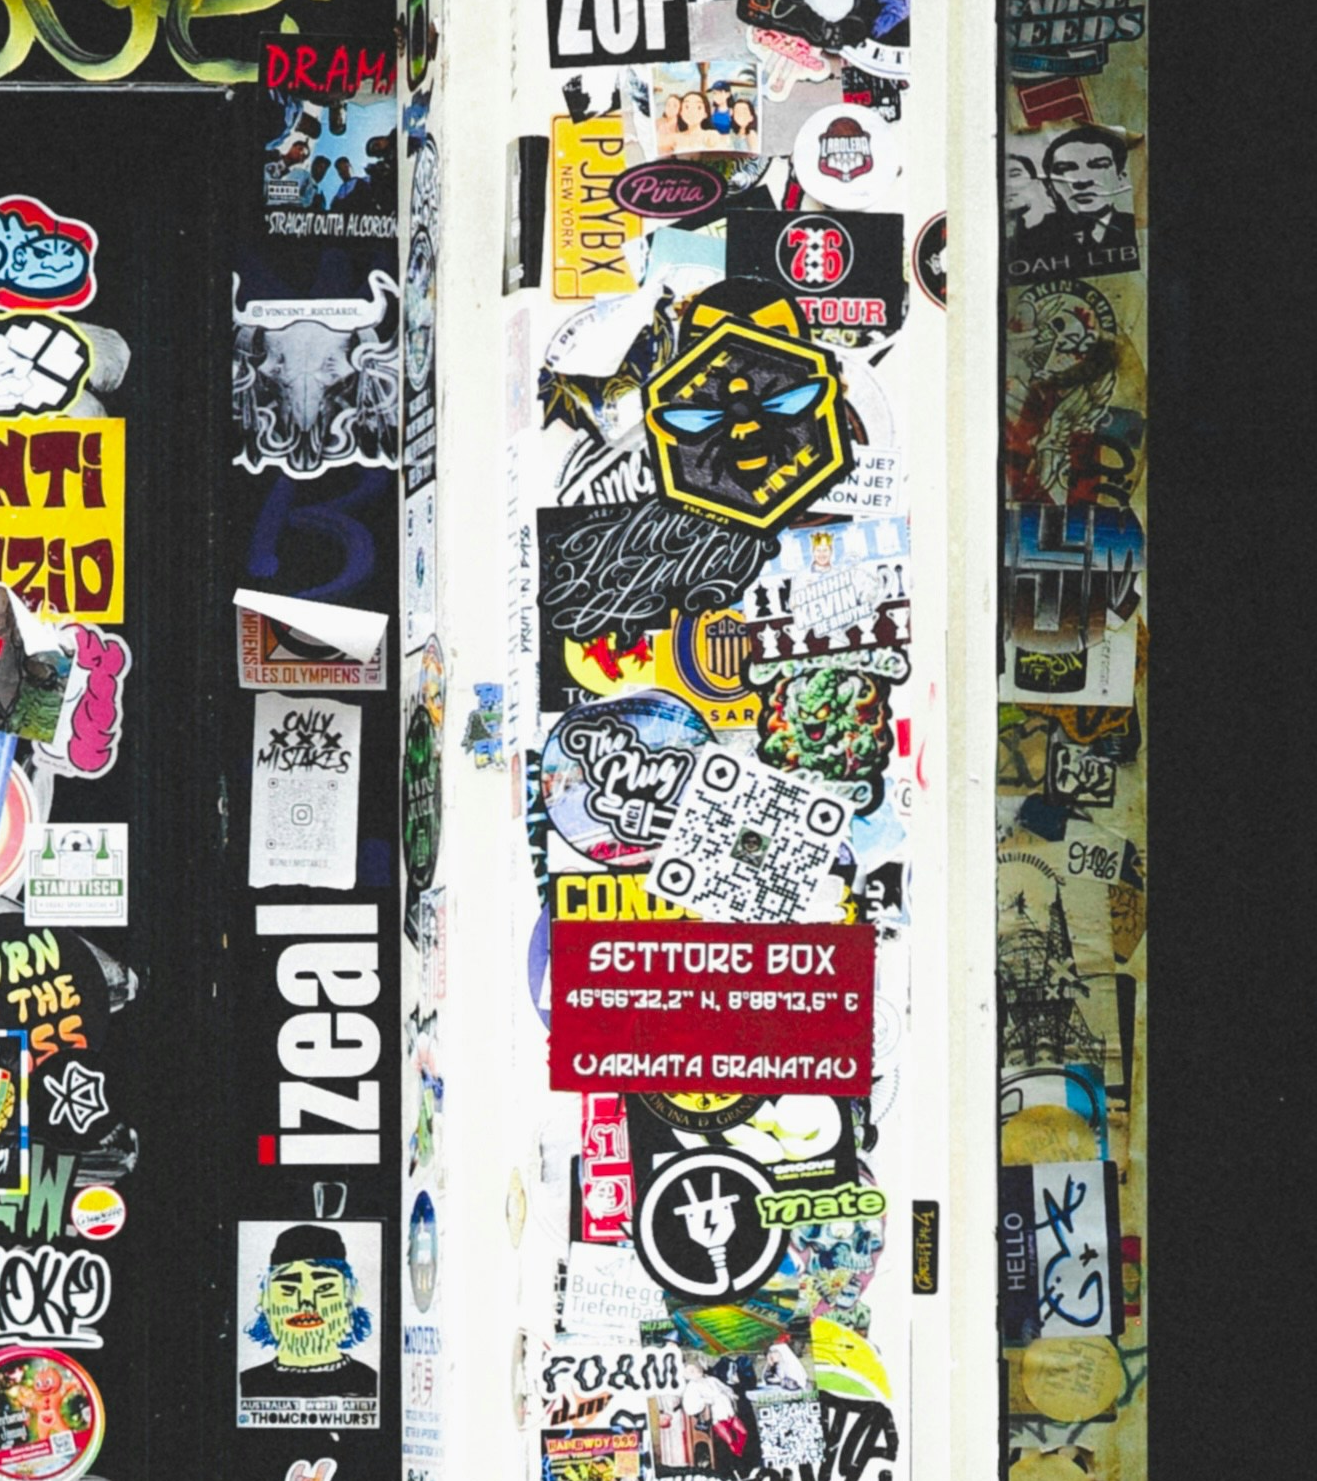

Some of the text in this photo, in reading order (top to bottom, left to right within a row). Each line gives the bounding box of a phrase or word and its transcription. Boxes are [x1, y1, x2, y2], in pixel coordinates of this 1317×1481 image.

[268, 210, 399, 239] STRAIGHT OUTTA ALCORCÓN
[1085, 241, 1139, 272] LTB
[801, 299, 886, 324] TOUR
[257, 746, 351, 773] MISTAKES
[32, 880, 121, 897] STAMMTISCH
[588, 942, 836, 976] SETTORE BOX
[255, 903, 382, 1166] izeal
[1006, 1209, 1025, 1294] HELLO
[238, 1413, 377, 1425] @THOMCROWHURST
